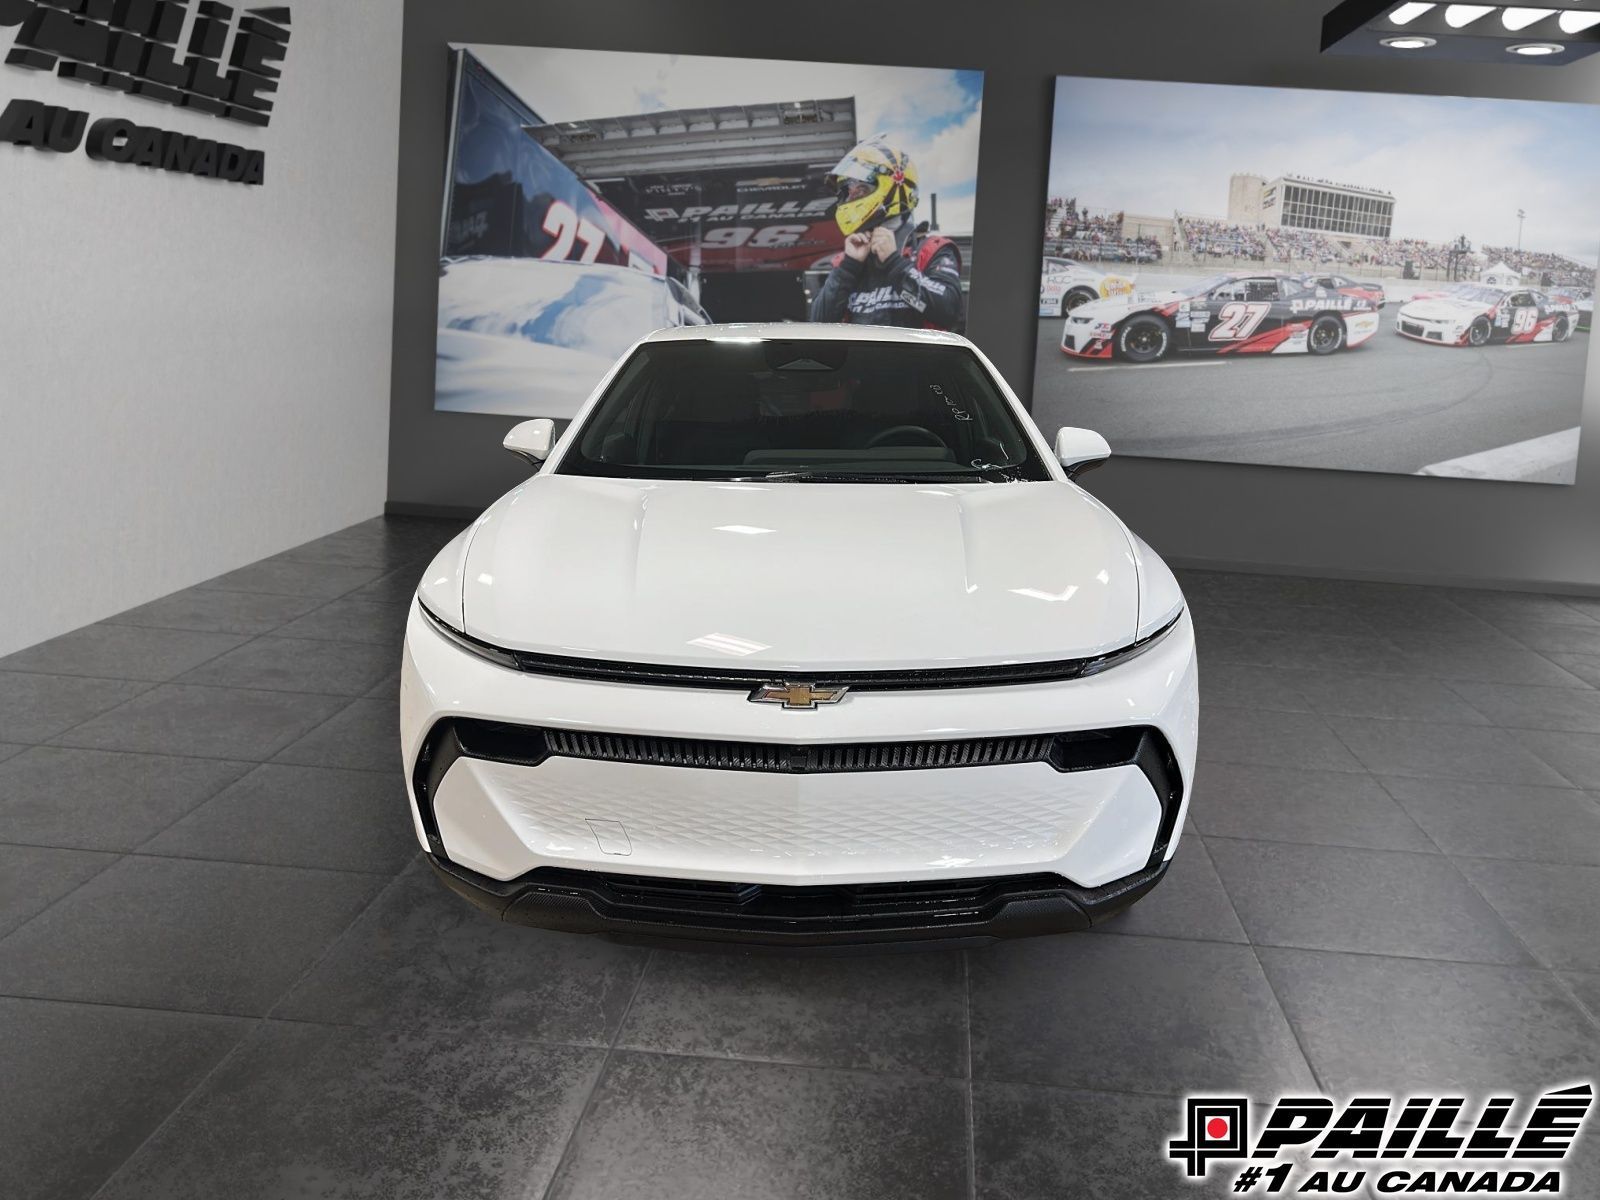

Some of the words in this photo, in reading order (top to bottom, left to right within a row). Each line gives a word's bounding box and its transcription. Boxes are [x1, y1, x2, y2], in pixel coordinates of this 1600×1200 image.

[0, 98, 90, 153] AU
[85, 117, 265, 185] CANADA
[540, 199, 606, 265] 27
[740, 211, 827, 220] CANADA
[701, 224, 809, 249] 96
[1208, 301, 1272, 342] 27
[1511, 306, 1539, 335] 96
